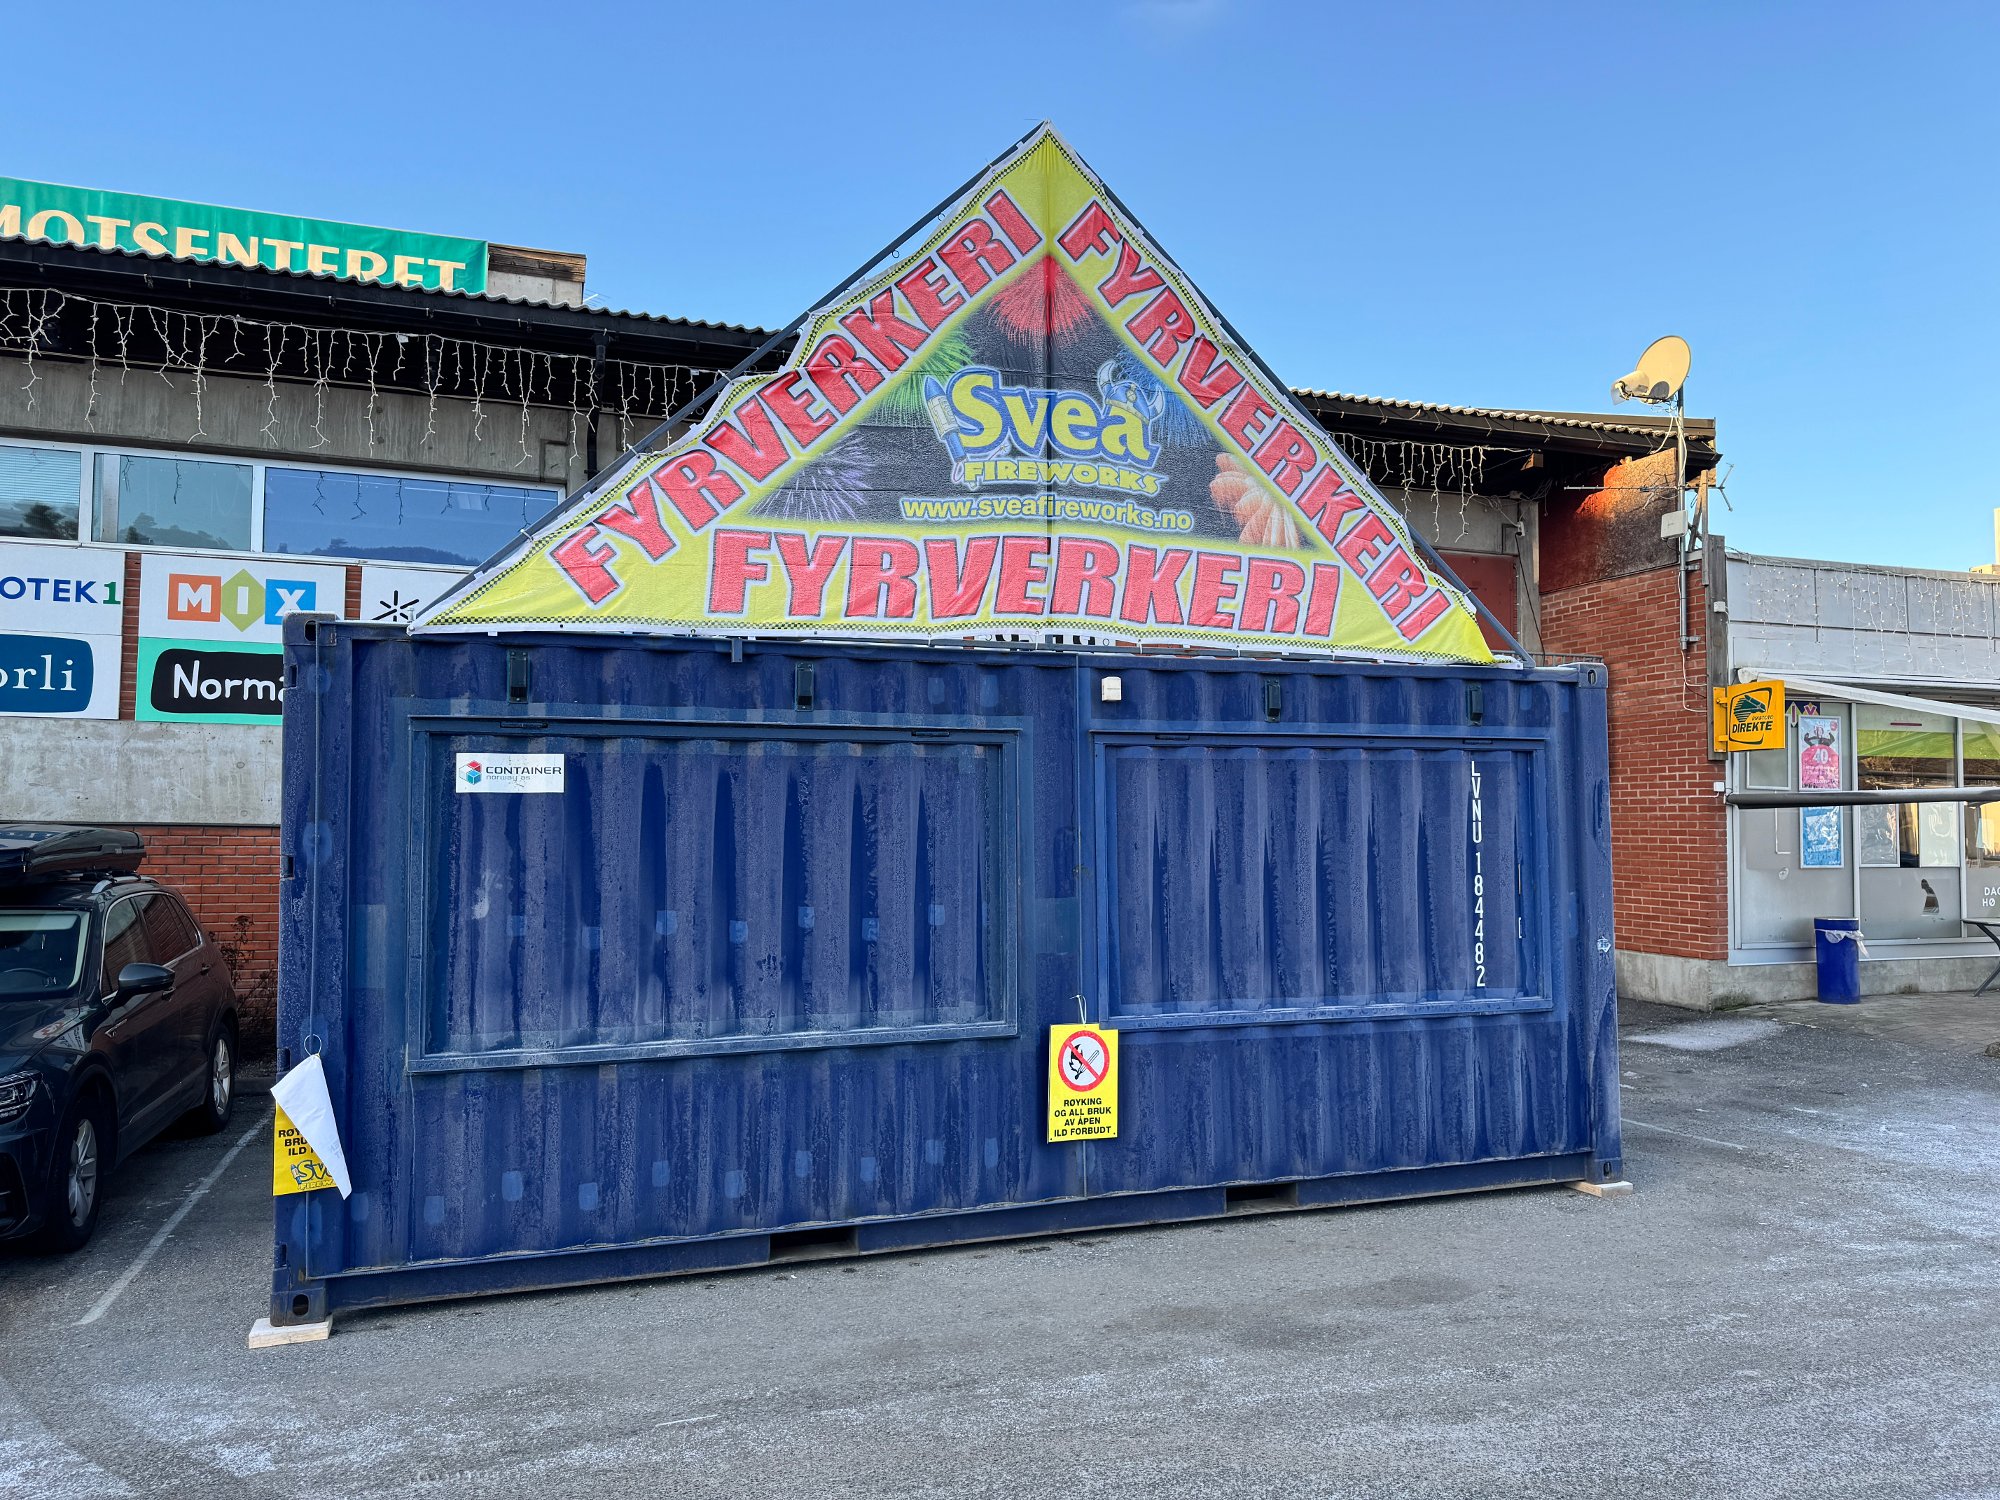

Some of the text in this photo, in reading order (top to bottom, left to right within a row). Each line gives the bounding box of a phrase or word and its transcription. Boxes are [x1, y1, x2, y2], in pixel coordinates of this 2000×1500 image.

[550, 190, 1042, 602] FYRVERKERI
[948, 369, 1158, 465] Svea
[1058, 200, 1452, 640] FYRVERKERI
[964, 460, 1162, 494] FIREWORKS
[902, 496, 1193, 530] www.sveafireworks.no
[708, 530, 1341, 638] FYRVERKERI
[177, 583, 306, 617] MIX
[1732, 721, 1773, 733] DIREKTE
[485, 766, 562, 775] CONTAINER
[1471, 760, 1485, 987] LVNU 184482
[1054, 1107, 1112, 1117] OG ALL BRUK
[1063, 1097, 1102, 1107] RØYKING
[1054, 1126, 1112, 1137] ILD FORBUDT
[1064, 1116, 1101, 1126] AV ÅPEN
[288, 1147, 307, 1156] ILD
[298, 1160, 332, 1182] Sv
